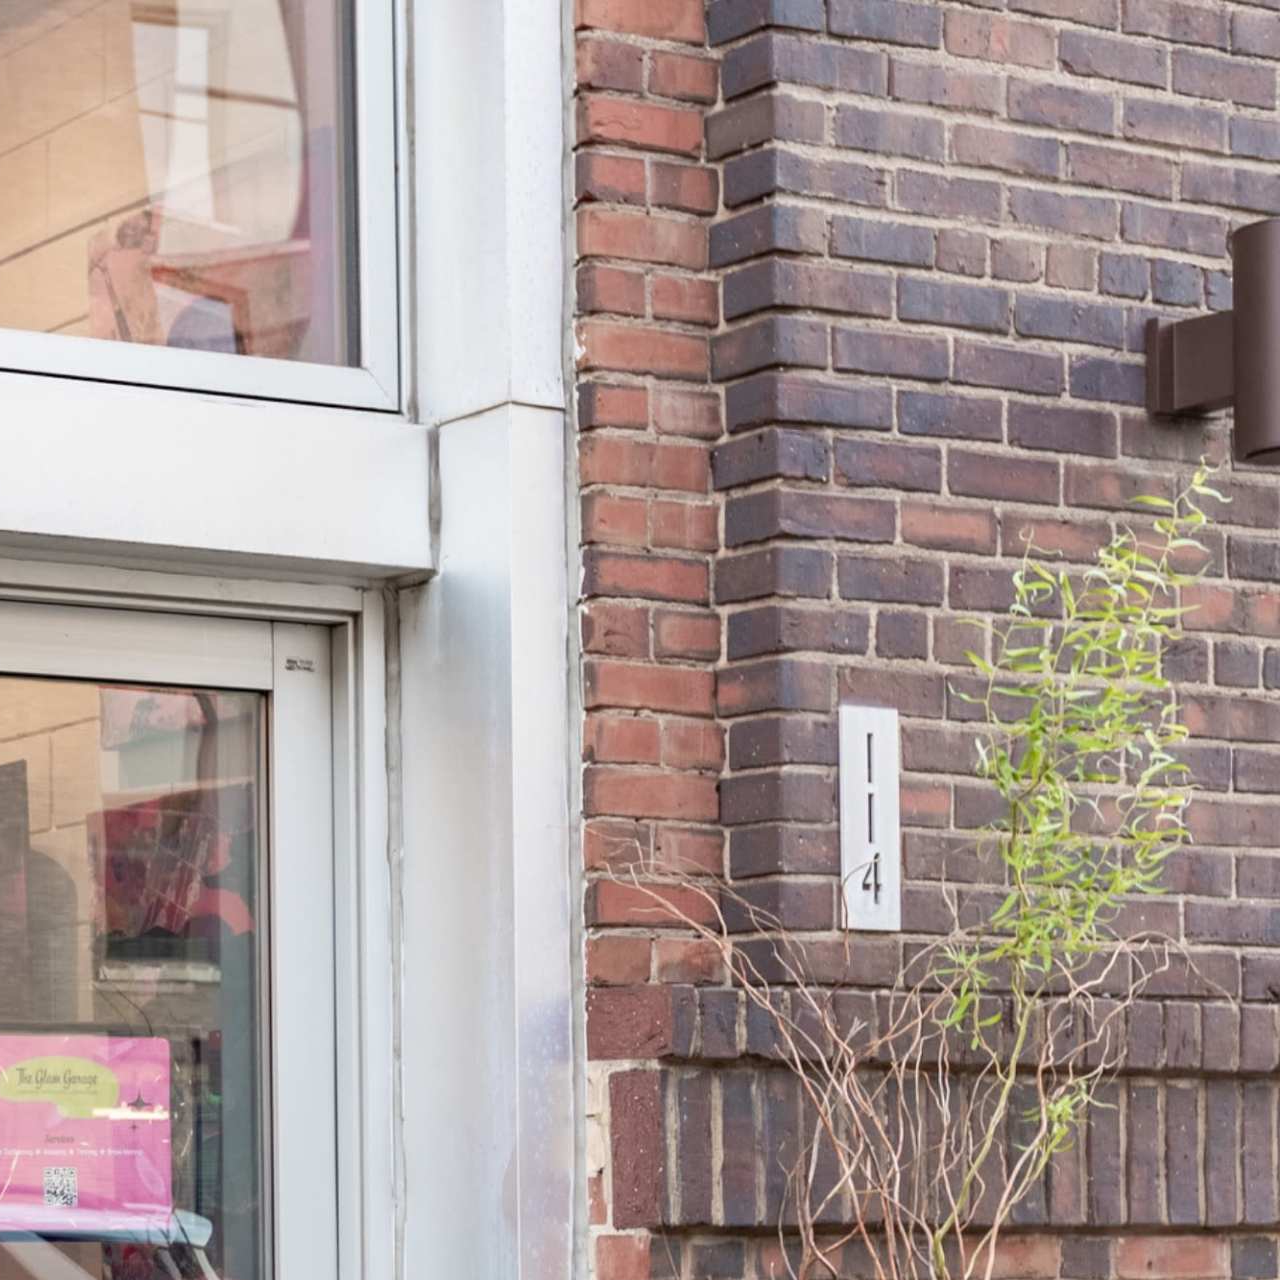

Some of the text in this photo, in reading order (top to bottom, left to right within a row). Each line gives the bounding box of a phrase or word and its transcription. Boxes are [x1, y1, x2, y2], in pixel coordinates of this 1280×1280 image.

[16, 1067, 98, 1090] The Glam Garage
